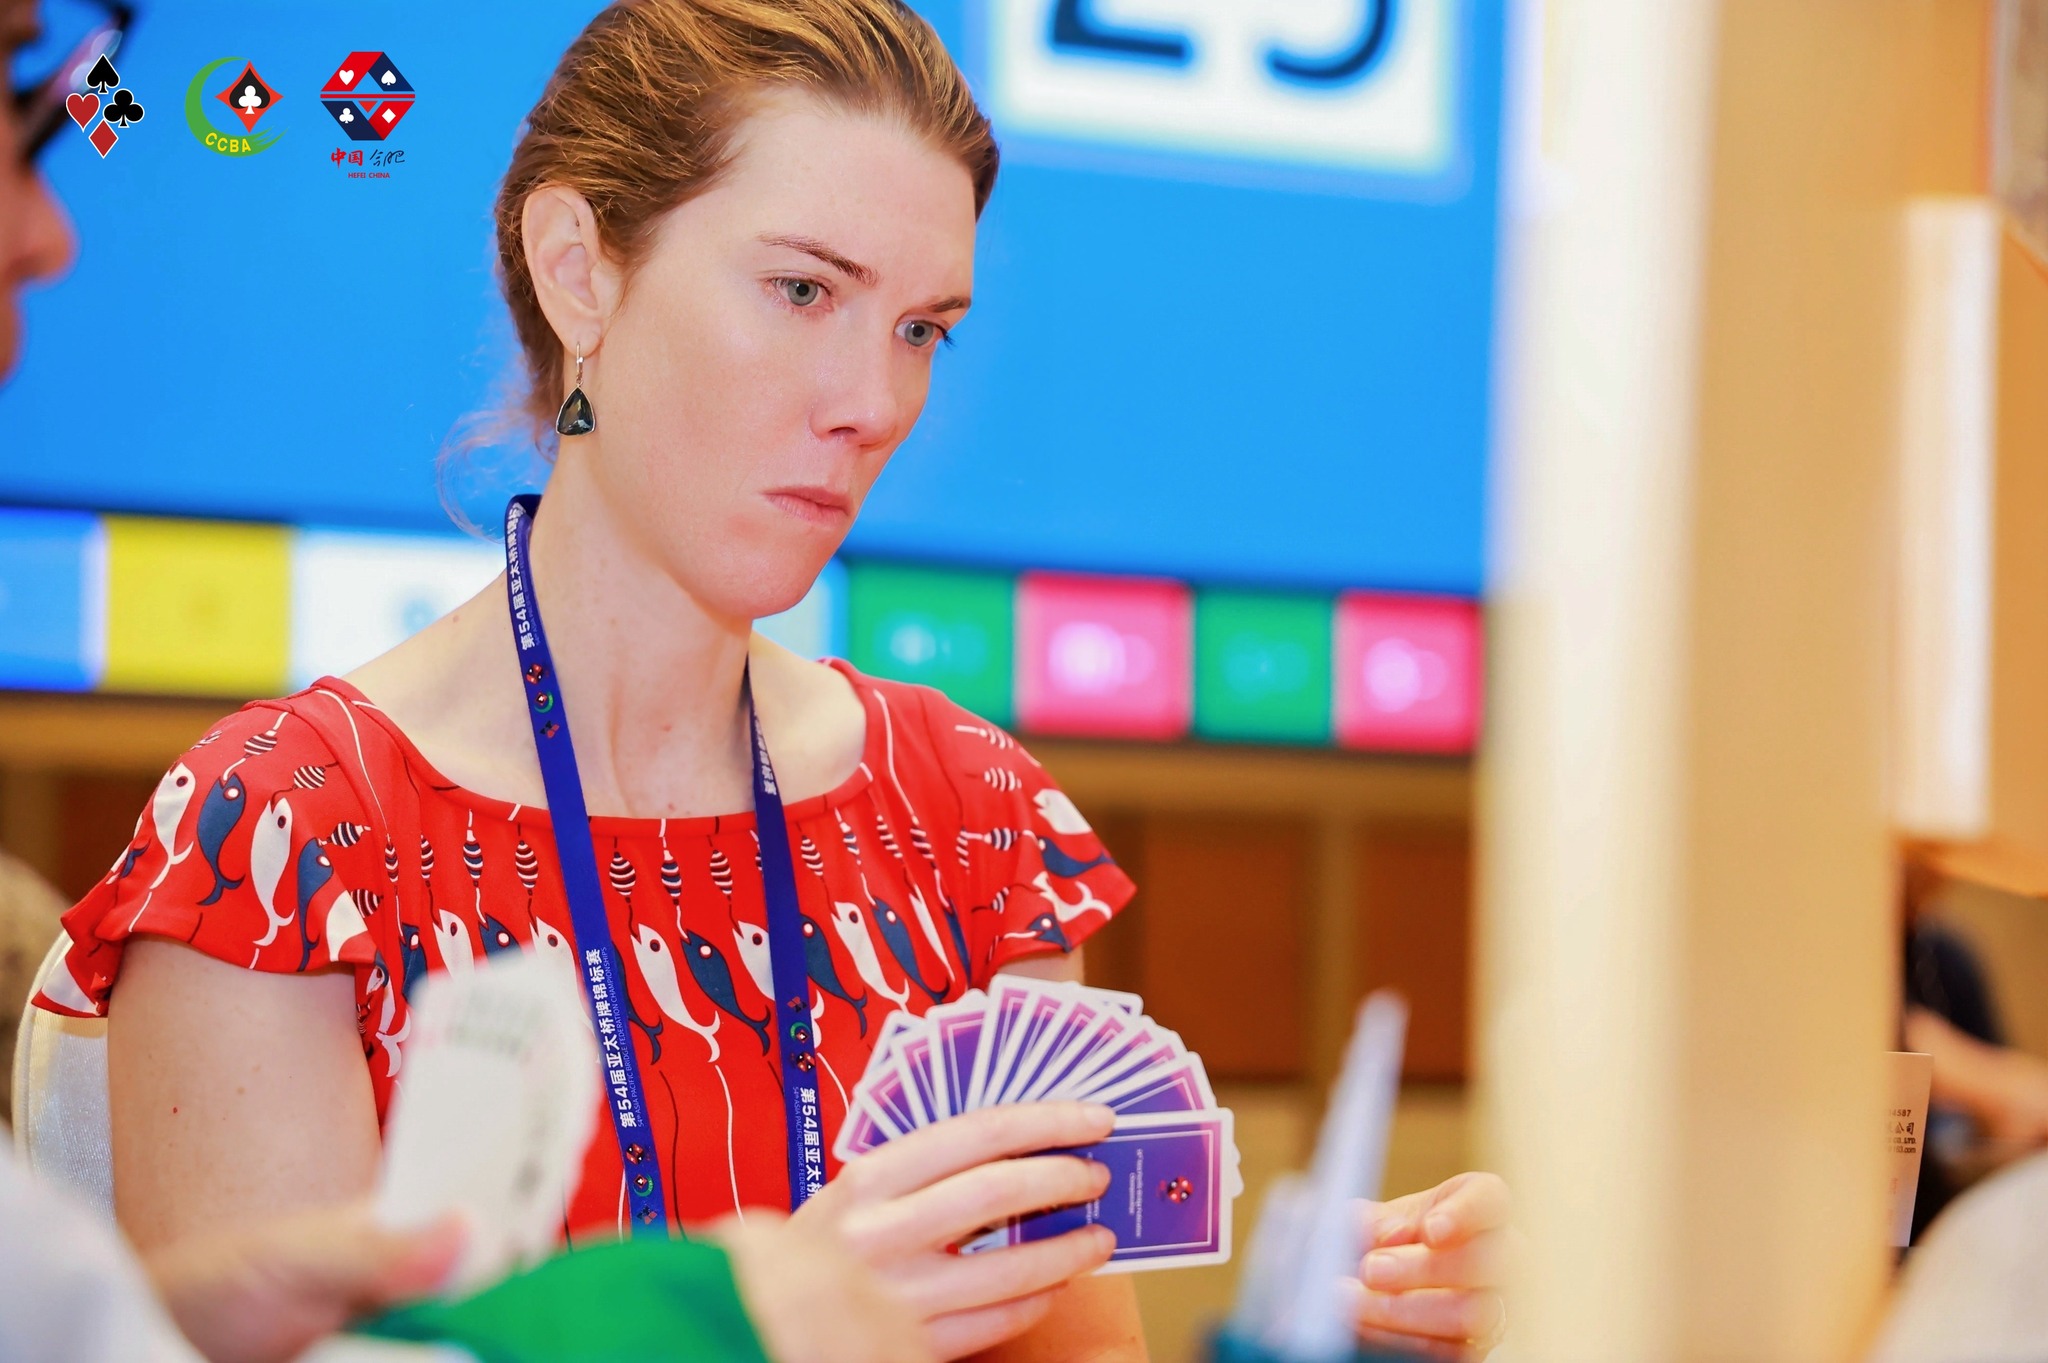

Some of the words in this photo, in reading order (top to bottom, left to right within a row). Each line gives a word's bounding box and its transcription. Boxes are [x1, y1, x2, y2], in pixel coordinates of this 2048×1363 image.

[601, 947, 617, 1003] CHAMPIONSHIPS
[612, 1004, 626, 1045] FEDERATION
[586, 949, 637, 1128] 第54届亚太桥牌锦标赛
[621, 1046, 632, 1071] BRIDGE
[626, 1072, 638, 1098] PACIFIC
[632, 1098, 641, 1114] ASIA
[795, 1116, 803, 1141] PACIFIC
[797, 1142, 805, 1167] BRIDGE
